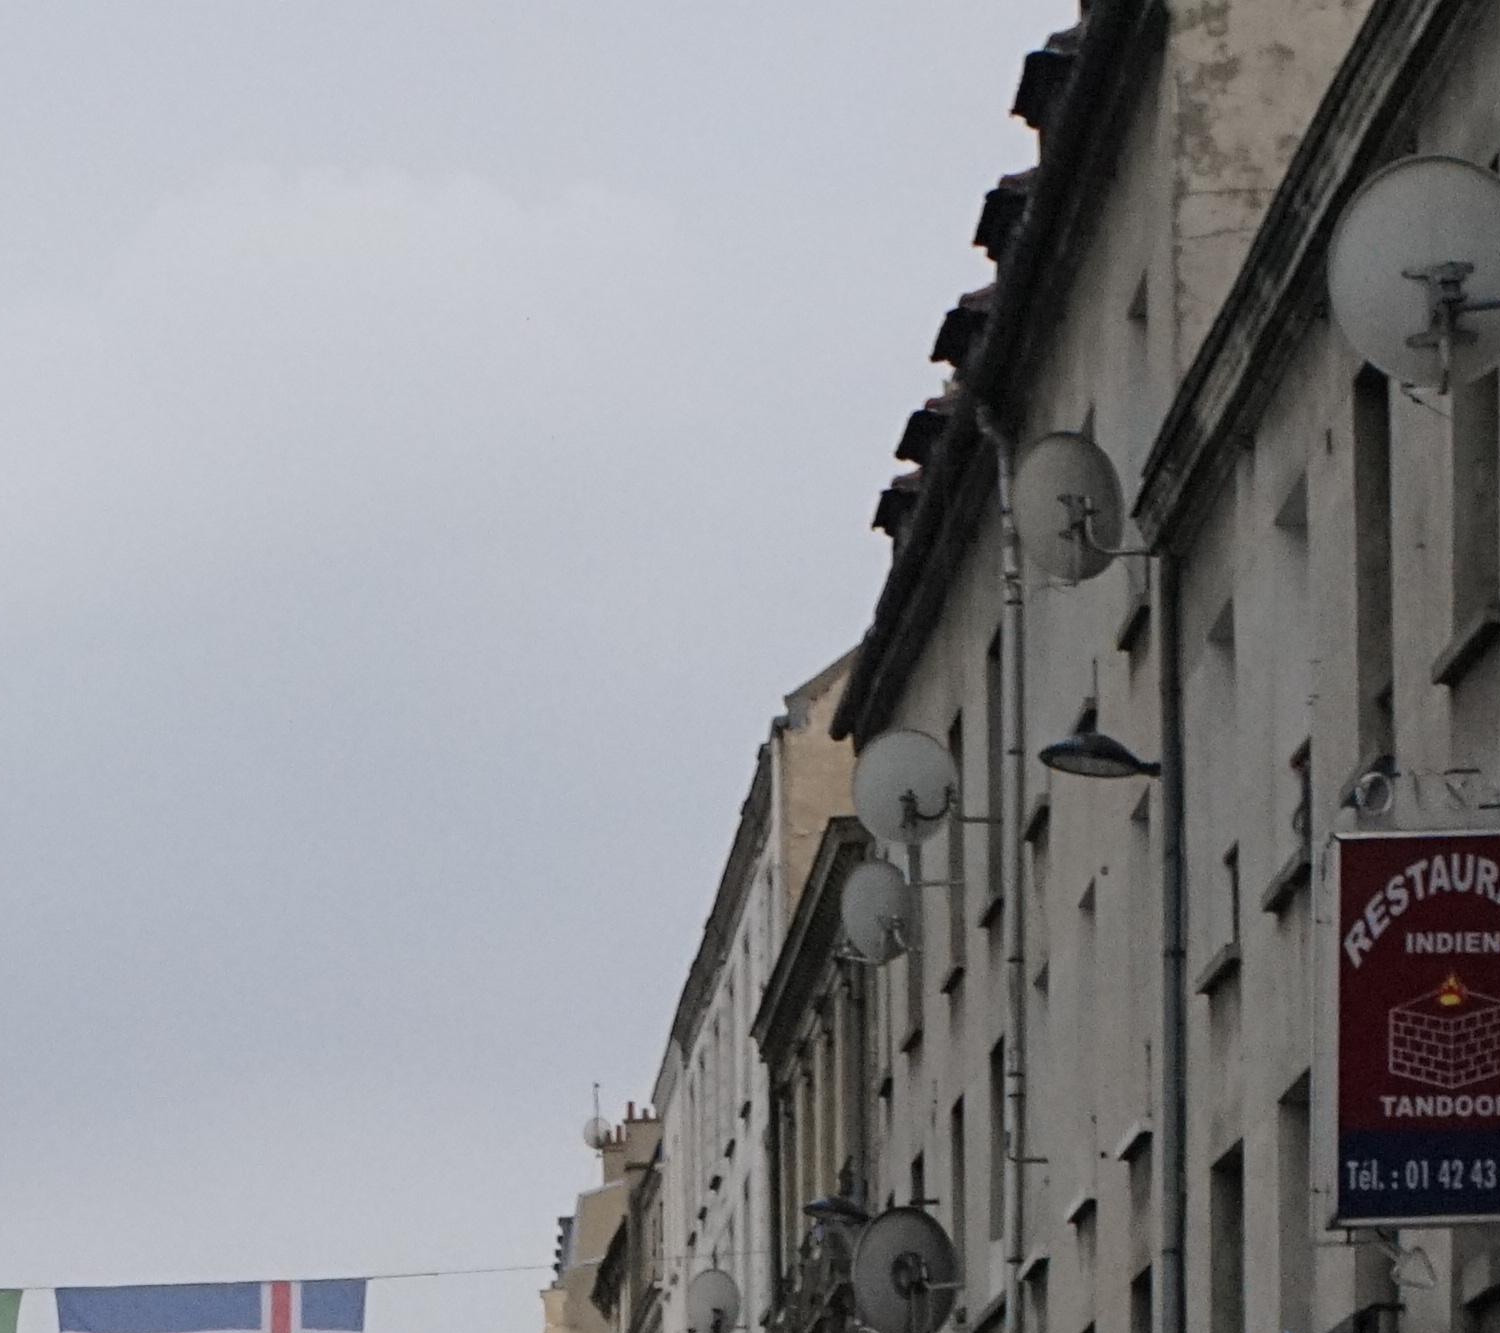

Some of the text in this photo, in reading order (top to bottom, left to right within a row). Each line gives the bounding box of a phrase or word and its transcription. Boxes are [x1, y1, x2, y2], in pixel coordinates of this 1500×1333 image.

[1346, 1160, 1384, 1191] Tél.
[1405, 1159, 1429, 1191] 01
[1439, 1159, 1464, 1190] 42
[1470, 1159, 1496, 1190] 43
